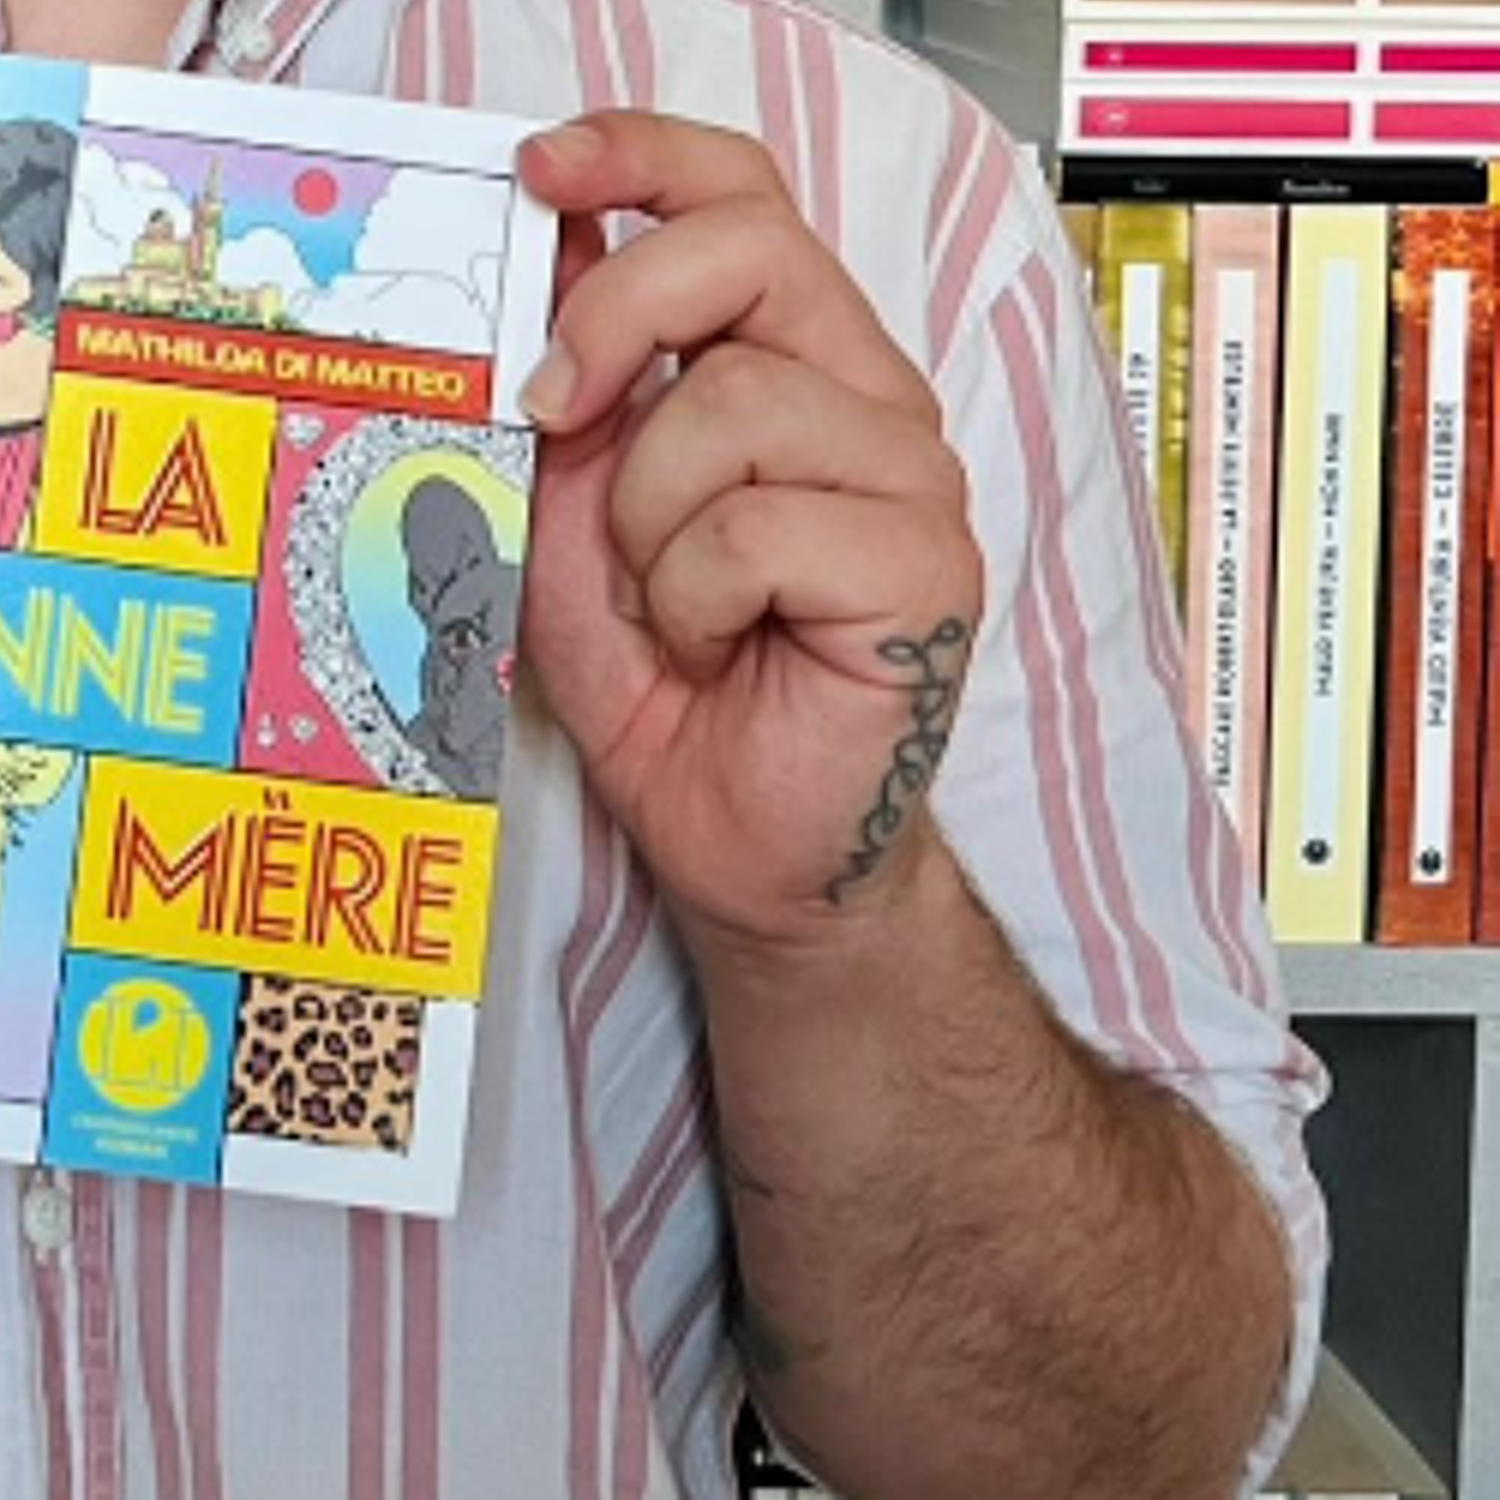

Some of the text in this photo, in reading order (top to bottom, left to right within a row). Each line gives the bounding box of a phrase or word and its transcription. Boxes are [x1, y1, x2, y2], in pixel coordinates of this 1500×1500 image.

[75, 322, 469, 404] MATHILDA DI MATTEO
[80, 408, 230, 548] LA
[106, 788, 464, 964] MÈRE
